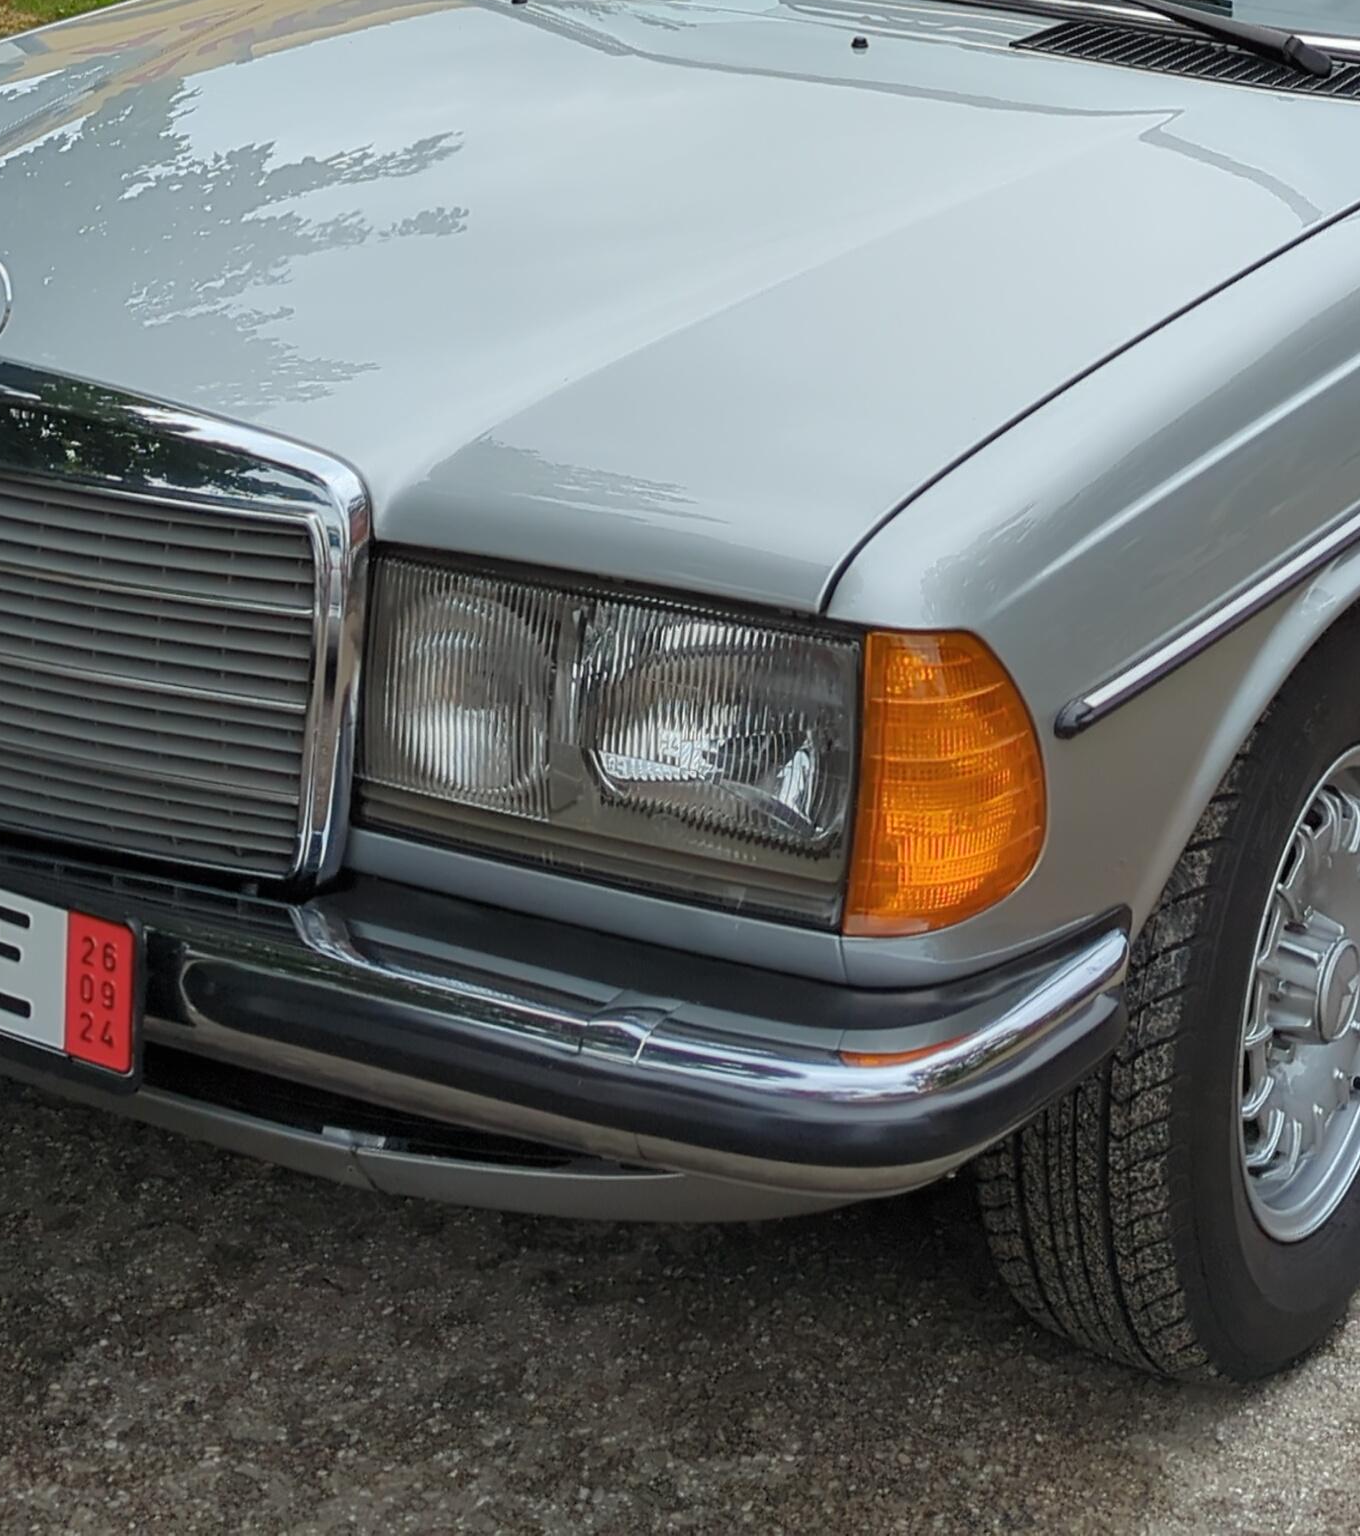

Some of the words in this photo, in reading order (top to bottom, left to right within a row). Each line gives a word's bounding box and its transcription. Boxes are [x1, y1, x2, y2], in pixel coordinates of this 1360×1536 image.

[80, 935, 118, 973] 26
[80, 974, 116, 1011] 09
[80, 1011, 115, 1050] 24
